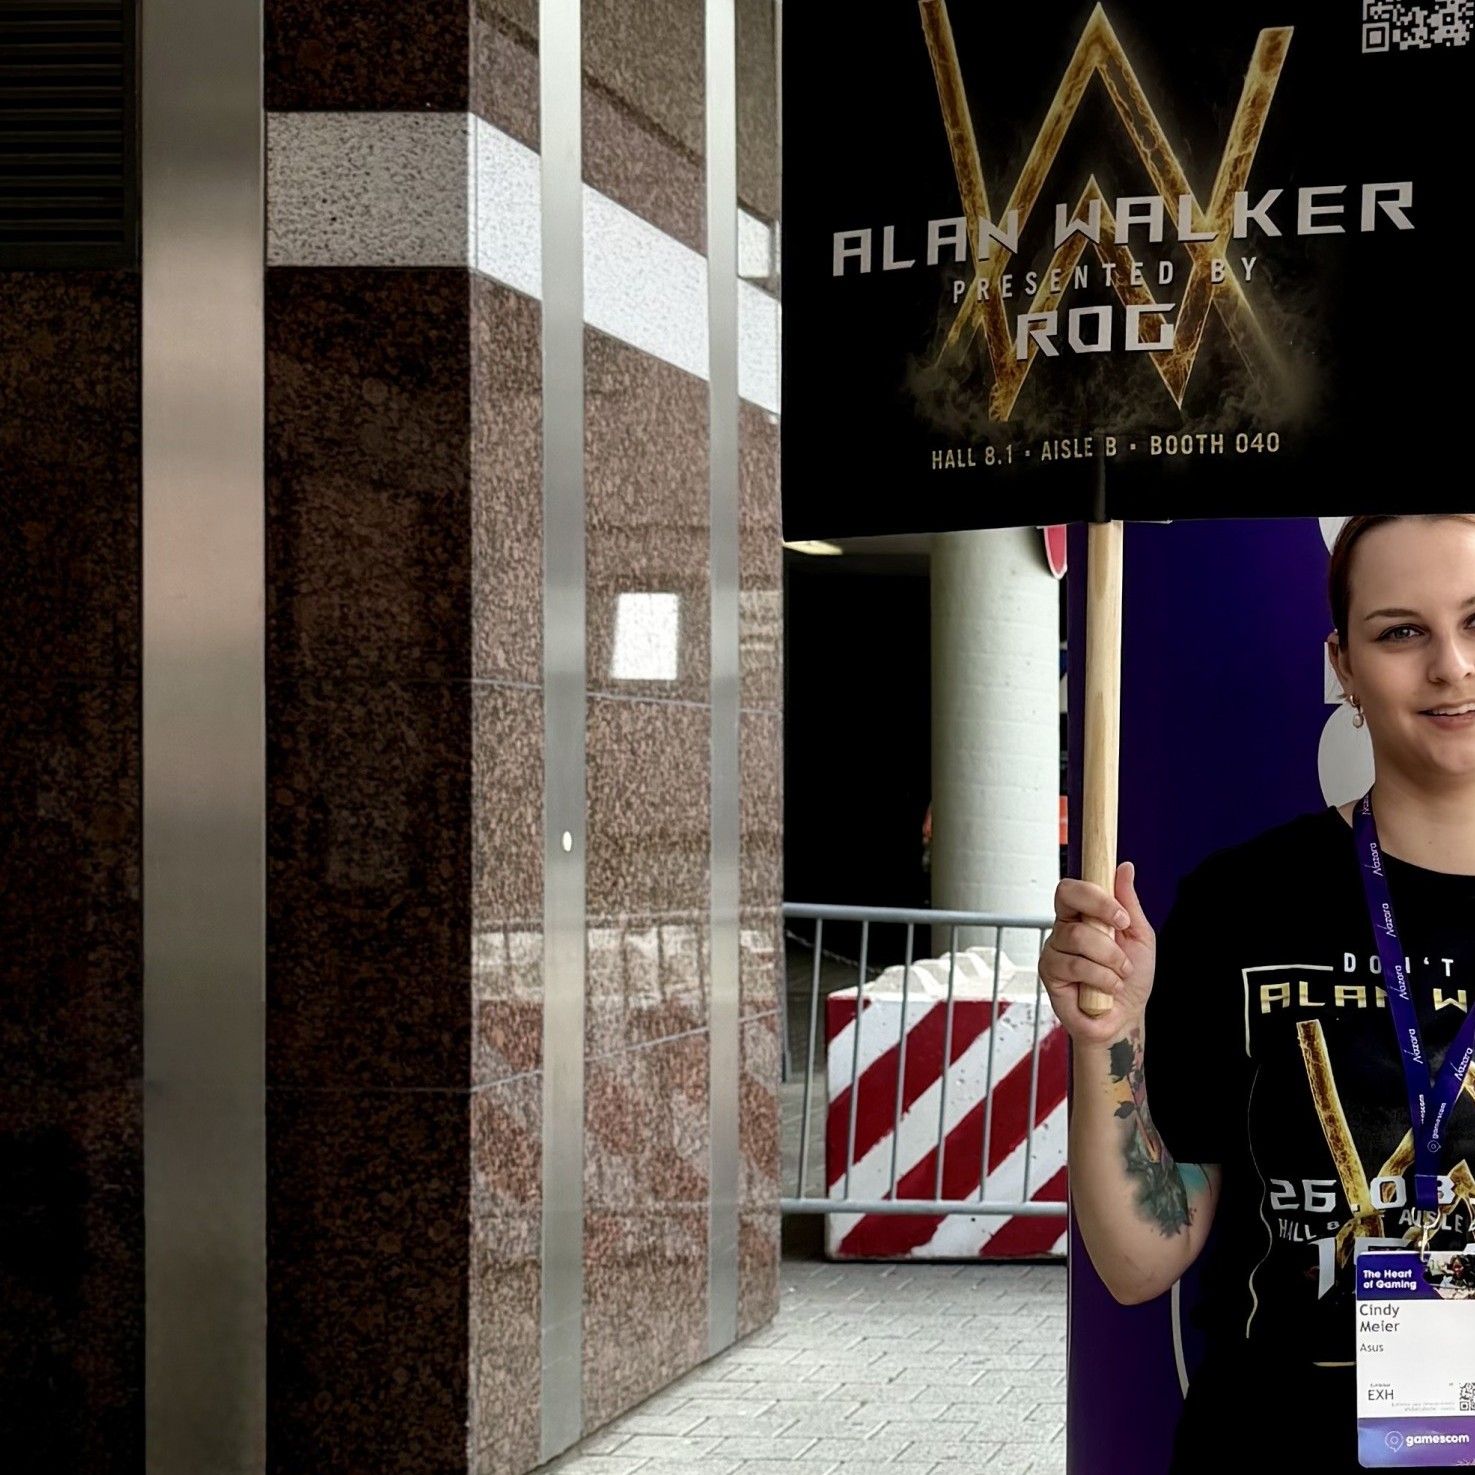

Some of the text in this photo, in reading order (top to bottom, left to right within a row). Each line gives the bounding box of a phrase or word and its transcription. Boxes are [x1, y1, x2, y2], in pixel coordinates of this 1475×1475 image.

[832, 181, 1415, 276] ALAN WALKER
[952, 256, 1258, 304] PRESENTED BY
[1016, 302, 1176, 361] ROG
[931, 431, 1280, 470] HALL 8.1 AISLE B BOOTH 040
[1364, 842, 1383, 876] Nazara
[1376, 903, 1397, 938] Nazara
[1389, 964, 1410, 1000] Nazara
[1403, 1028, 1423, 1064] Nazara
[1450, 1047, 1474, 1082] Nazara
[1432, 1102, 1447, 1139] gamescom
[1278, 1218, 1317, 1242] HALL
[1363, 1269, 1412, 1279] The Heart
[1363, 1280, 1417, 1291] of Gaming
[1359, 1303, 1400, 1318] Cindy
[1359, 1320, 1400, 1332] Meier
[1360, 1343, 1384, 1353] Asus
[1368, 1389, 1394, 1401] EXH
[1406, 1433, 1470, 1447] gamescom
